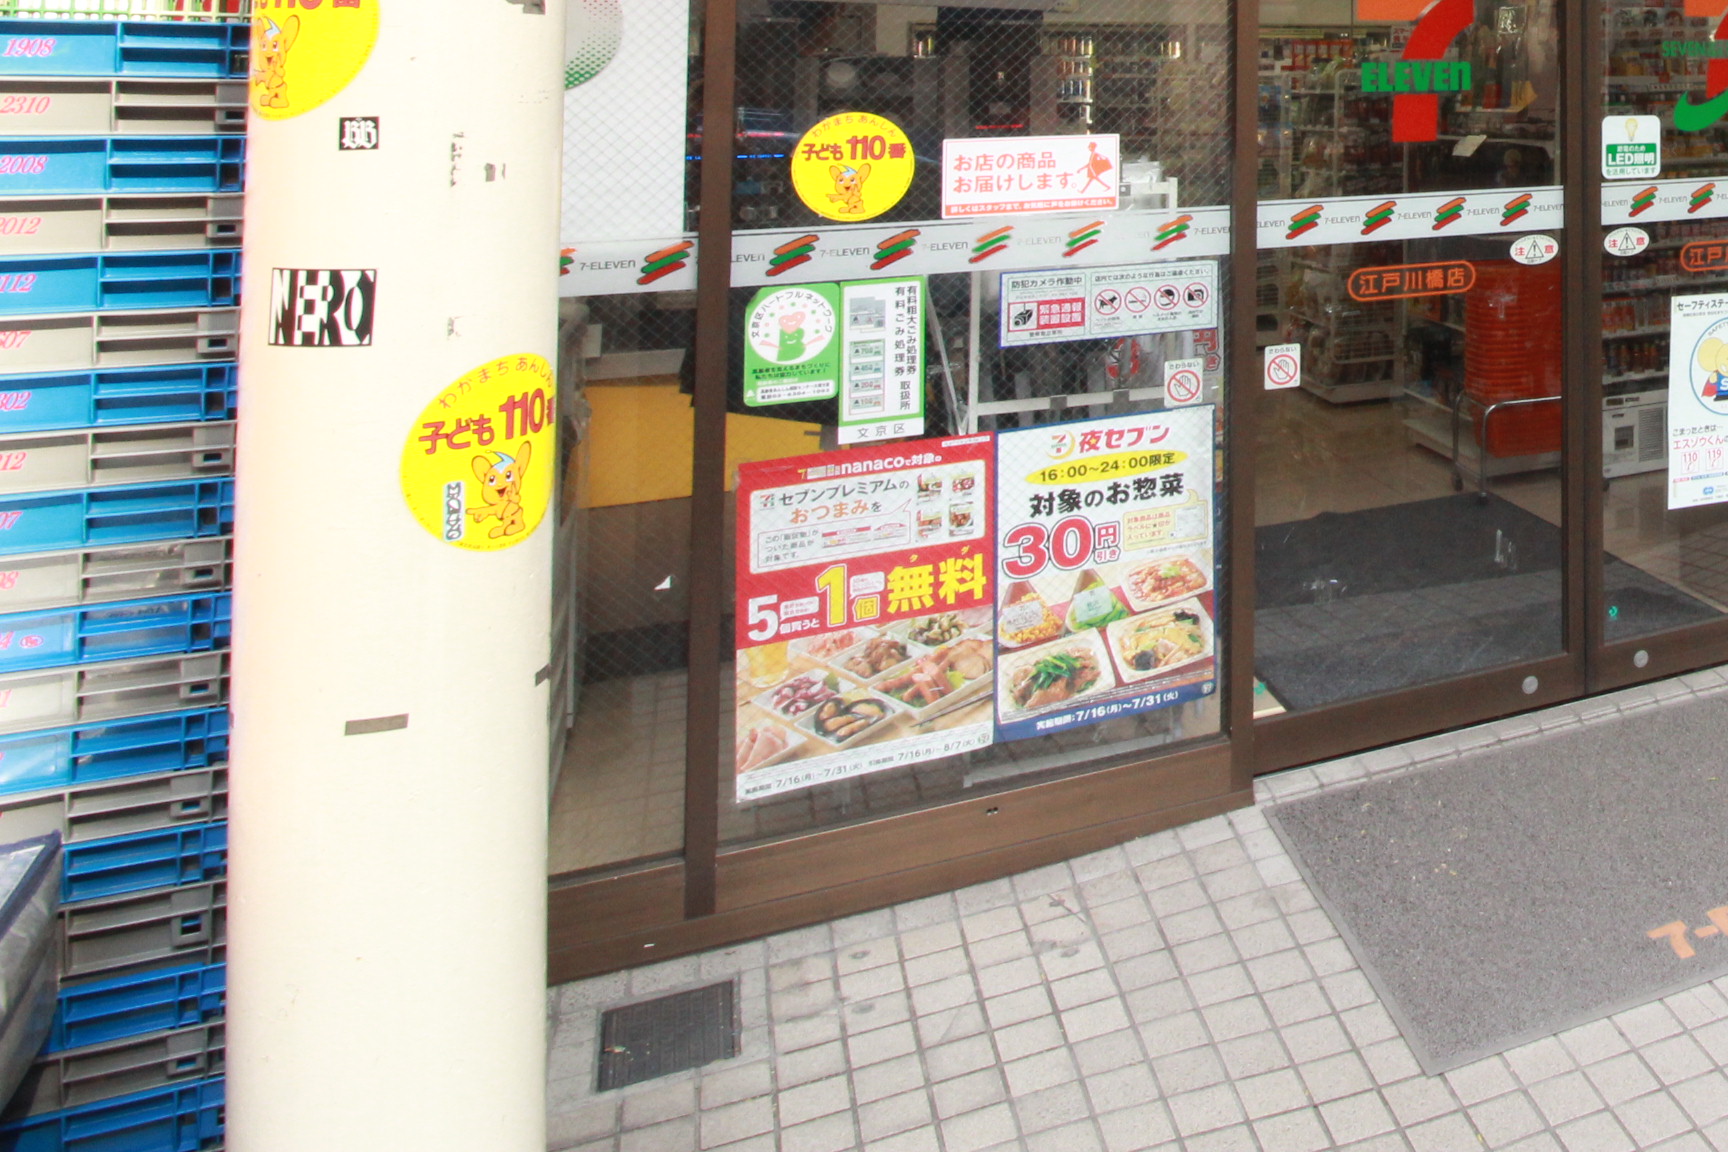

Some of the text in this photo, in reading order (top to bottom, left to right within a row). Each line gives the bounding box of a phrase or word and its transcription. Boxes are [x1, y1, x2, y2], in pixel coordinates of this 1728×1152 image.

[2, 38, 56, 57] 1908
[0, 96, 50, 114] 2310
[0, 156, 48, 175] 2008
[952, 151, 1057, 172] お店の商品
[1607, 152, 1655, 165] LED照明
[952, 172, 1077, 194] お届けします。
[1011, 276, 1083, 289] 防犯カメラ作動中
[1359, 267, 1466, 295] 江戸川橋店
[894, 286, 906, 377] 有料ごみ処理券
[906, 285, 918, 375] 有料粗大ごみ処理券
[1268, 345, 1298, 355] さわらない
[1167, 360, 1201, 370] さわらない
[900, 380, 911, 410] 取扱所
[857, 423, 905, 439] 文京区
[1079, 425, 1170, 454] 夜セブン
[1683, 449, 1722, 463] 110 119
[780, 479, 910, 507] セブンプレミアムの
[1029, 472, 1185, 518] 対象のお惣菜
[790, 499, 882, 525] おつまみを
[748, 595, 779, 641] 5
[887, 553, 987, 614] 無料
